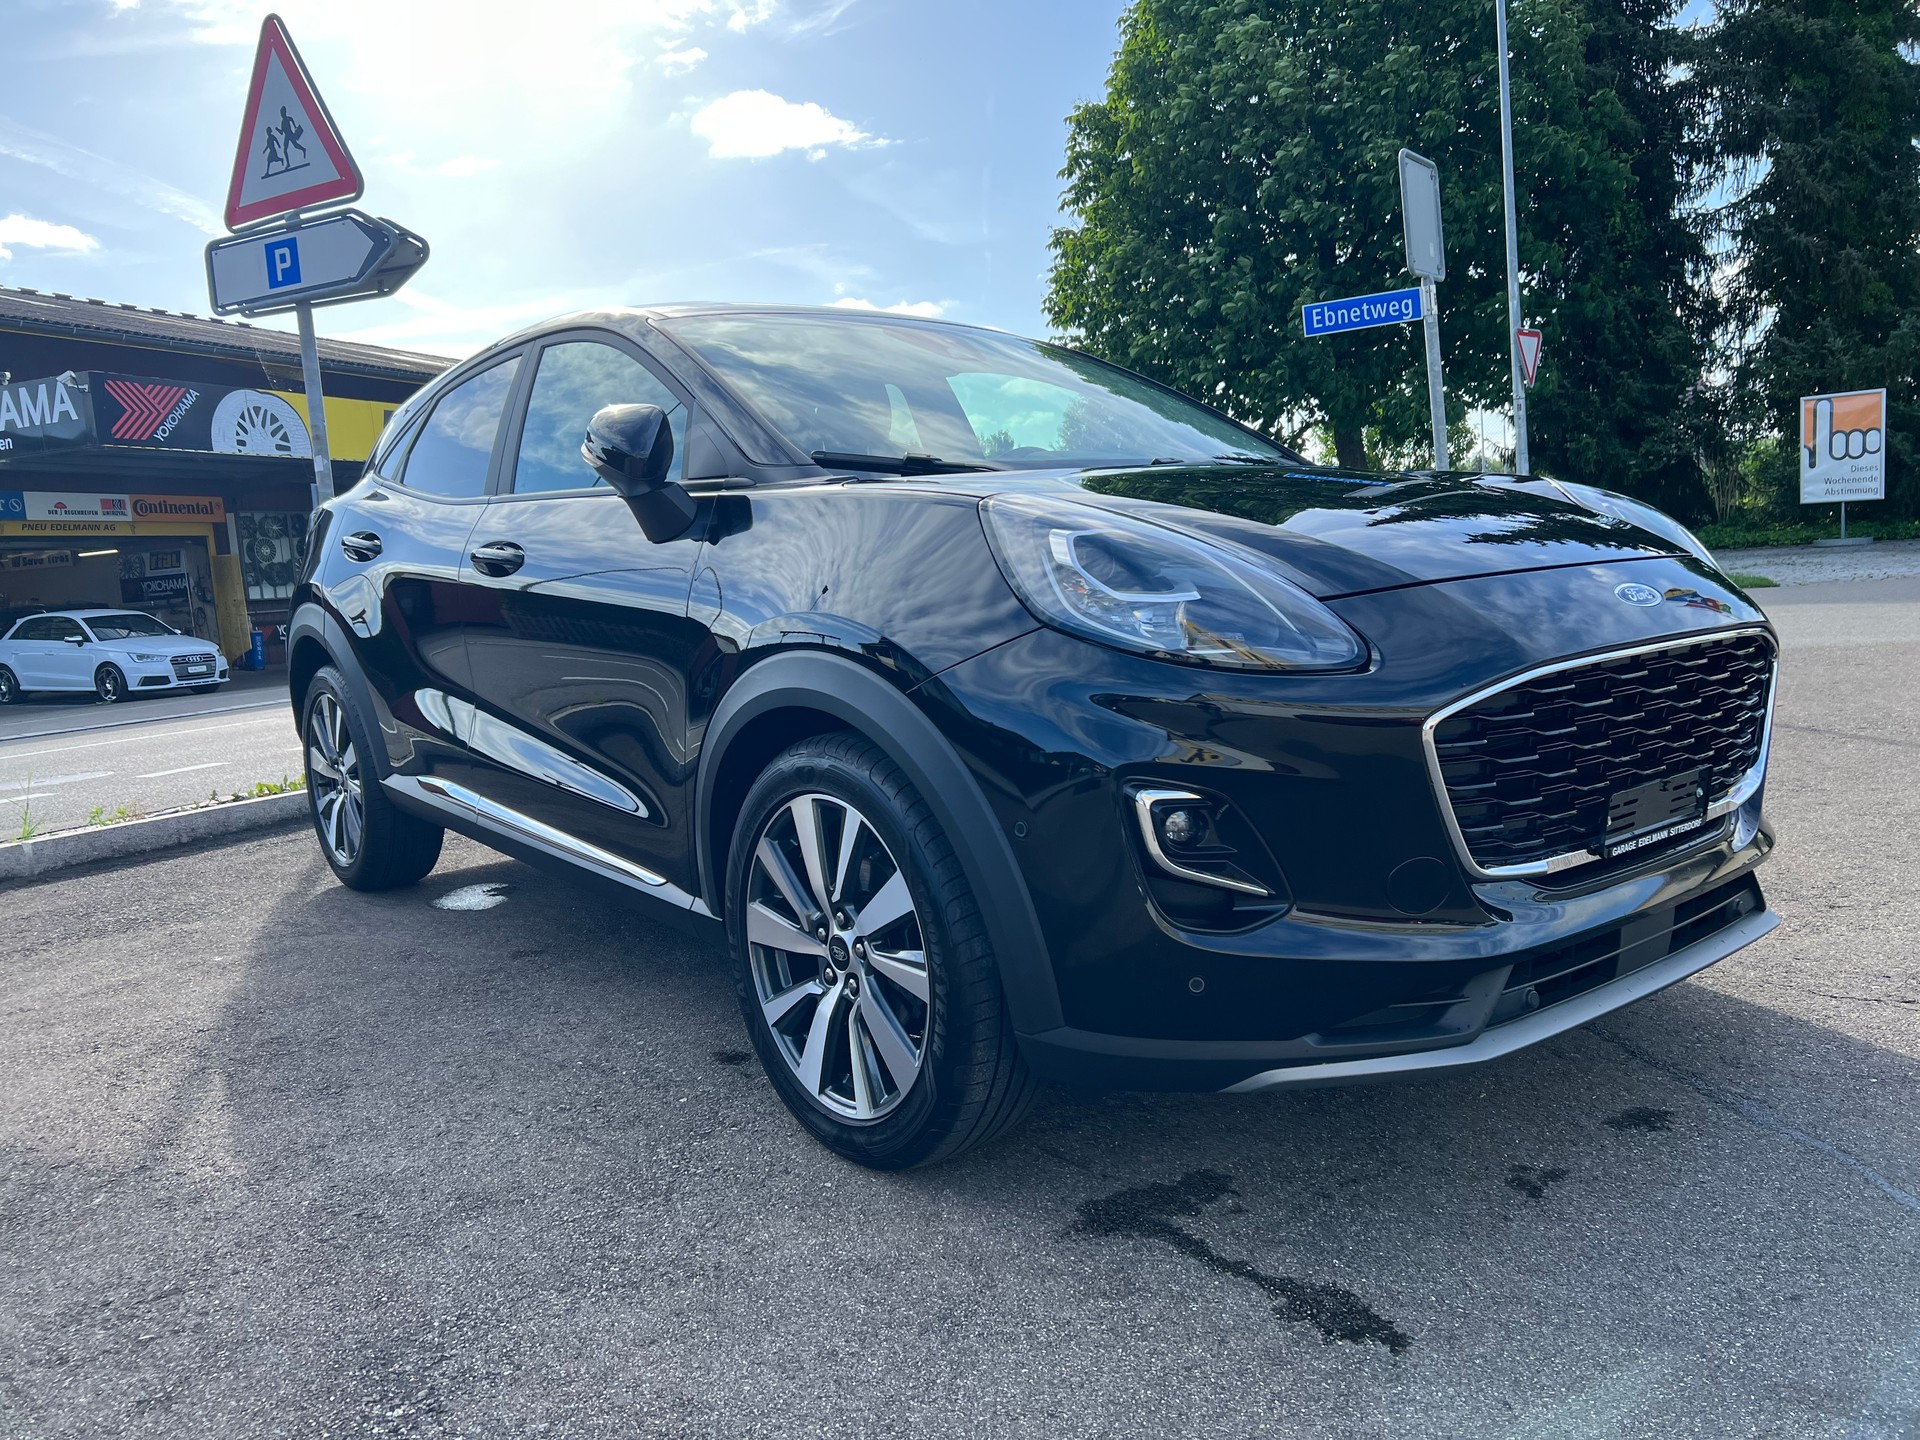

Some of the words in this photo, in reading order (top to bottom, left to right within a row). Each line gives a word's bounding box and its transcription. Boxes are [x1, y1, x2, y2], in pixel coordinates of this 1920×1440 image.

[273, 247, 291, 281] P
[1312, 298, 1413, 328] Ebnetweg
[153, 389, 200, 441] YOKOHAMA
[1850, 464, 1879, 472] Dieses
[1824, 475, 1879, 485] Wochenende
[1824, 486, 1879, 496] Abstimmung
[132, 499, 214, 517] Continental
[21, 523, 47, 531] PNEU
[50, 523, 101, 531] EDELMANN
[103, 523, 116, 531] AG
[140, 577, 187, 593] YOKOHAMA
[1624, 587, 1653, 601] Ford
[1612, 841, 1637, 856] GARAGE
[1638, 829, 1669, 847] EDELMANN
[1669, 818, 1703, 836] SITTERDORF
